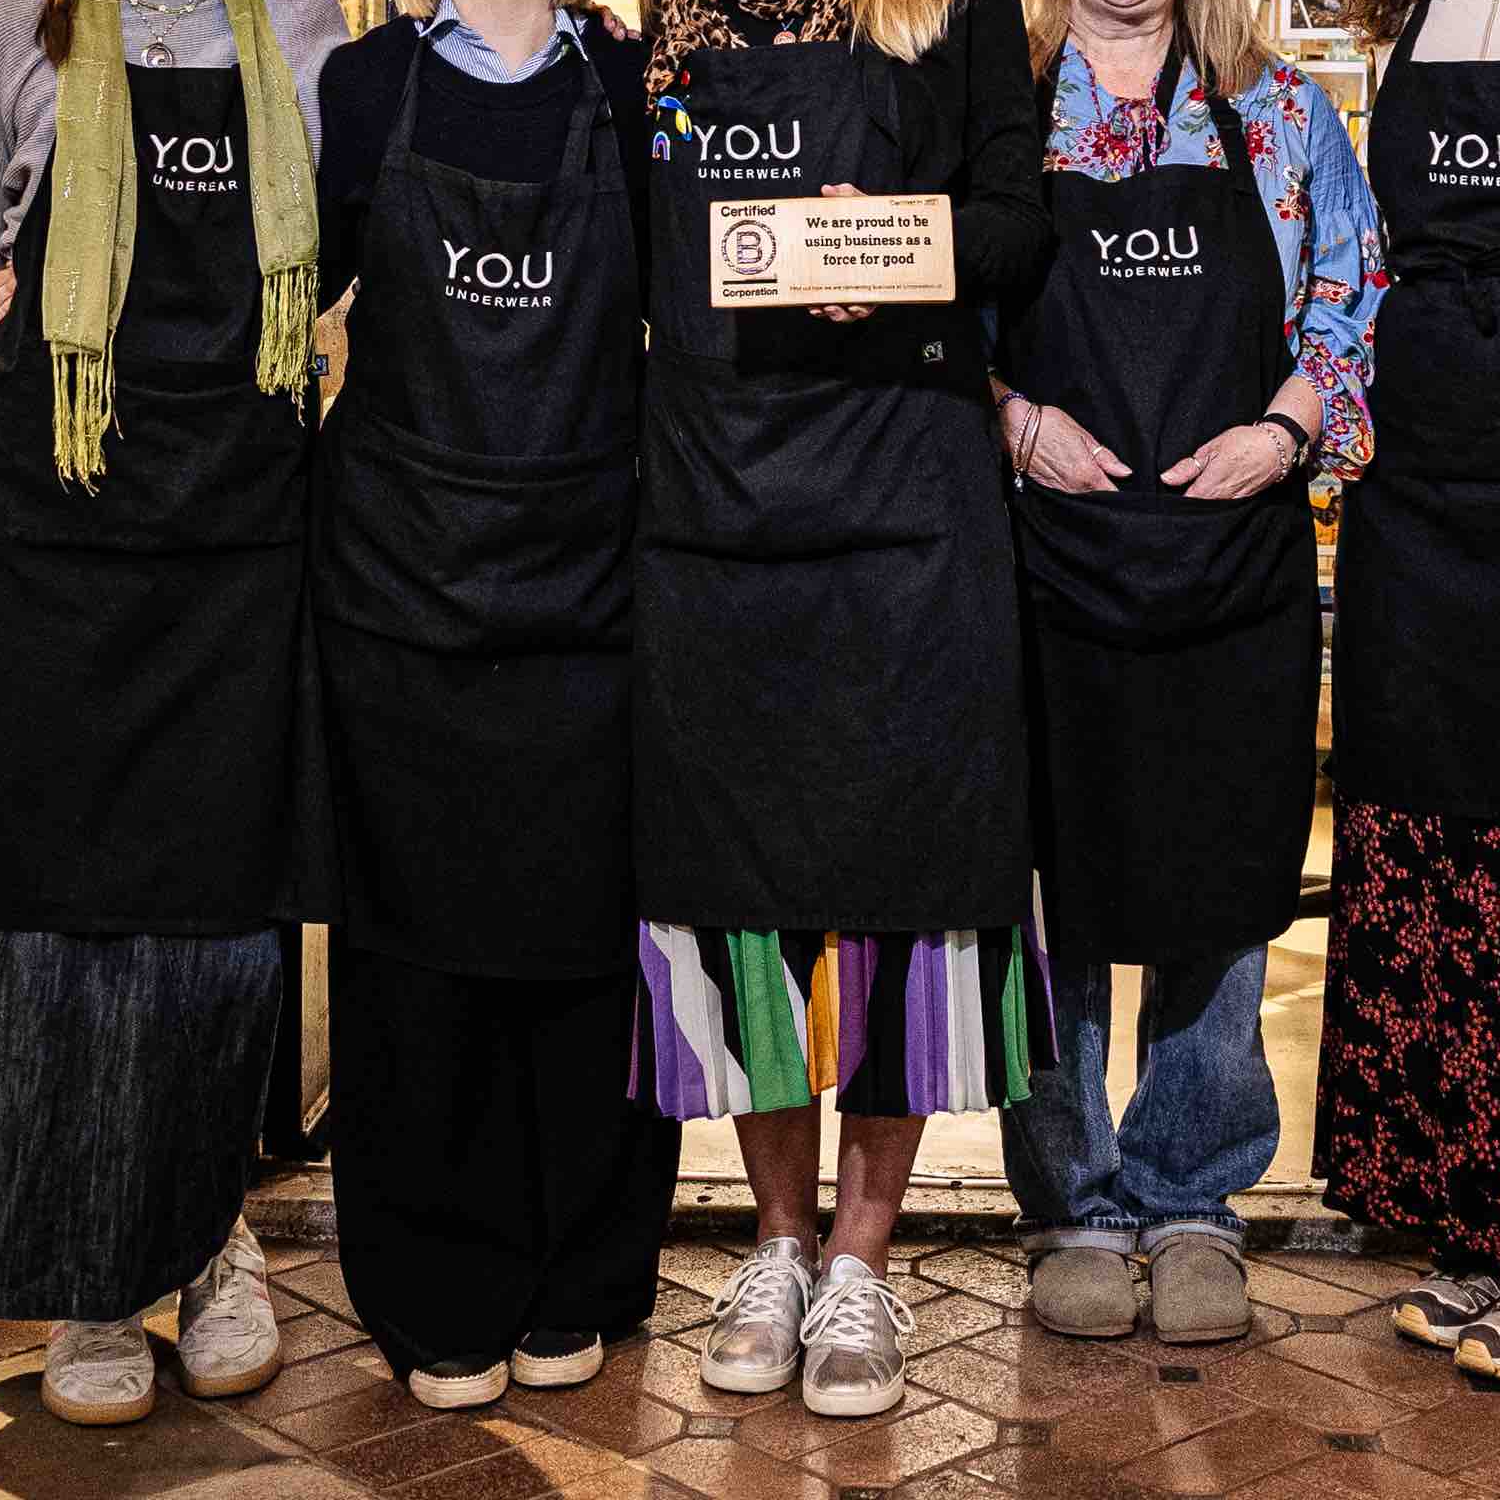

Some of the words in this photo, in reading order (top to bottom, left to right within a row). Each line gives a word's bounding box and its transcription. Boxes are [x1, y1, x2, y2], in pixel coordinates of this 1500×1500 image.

[694, 120, 801, 162] Y.O.U
[697, 166, 802, 180] UNDERWEAR
[720, 204, 776, 217] Certified
[806, 218, 828, 228] We
[832, 218, 852, 228] are
[856, 216, 894, 230] proud
[898, 218, 910, 227] to
[913, 215, 929, 227] be
[805, 237, 841, 249] using
[845, 235, 903, 246] business
[906, 236, 920, 245] as
[924, 236, 931, 245] a
[1091, 226, 1200, 263] Y.O.U
[443, 240, 553, 289] Y.O.U
[823, 254, 857, 265] force
[860, 253, 879, 265] for
[883, 253, 915, 267] good
[1100, 263, 1203, 278] UNDERWEAR
[444, 285, 553, 308] UNDERWEAR
[722, 287, 778, 298] Corporation
